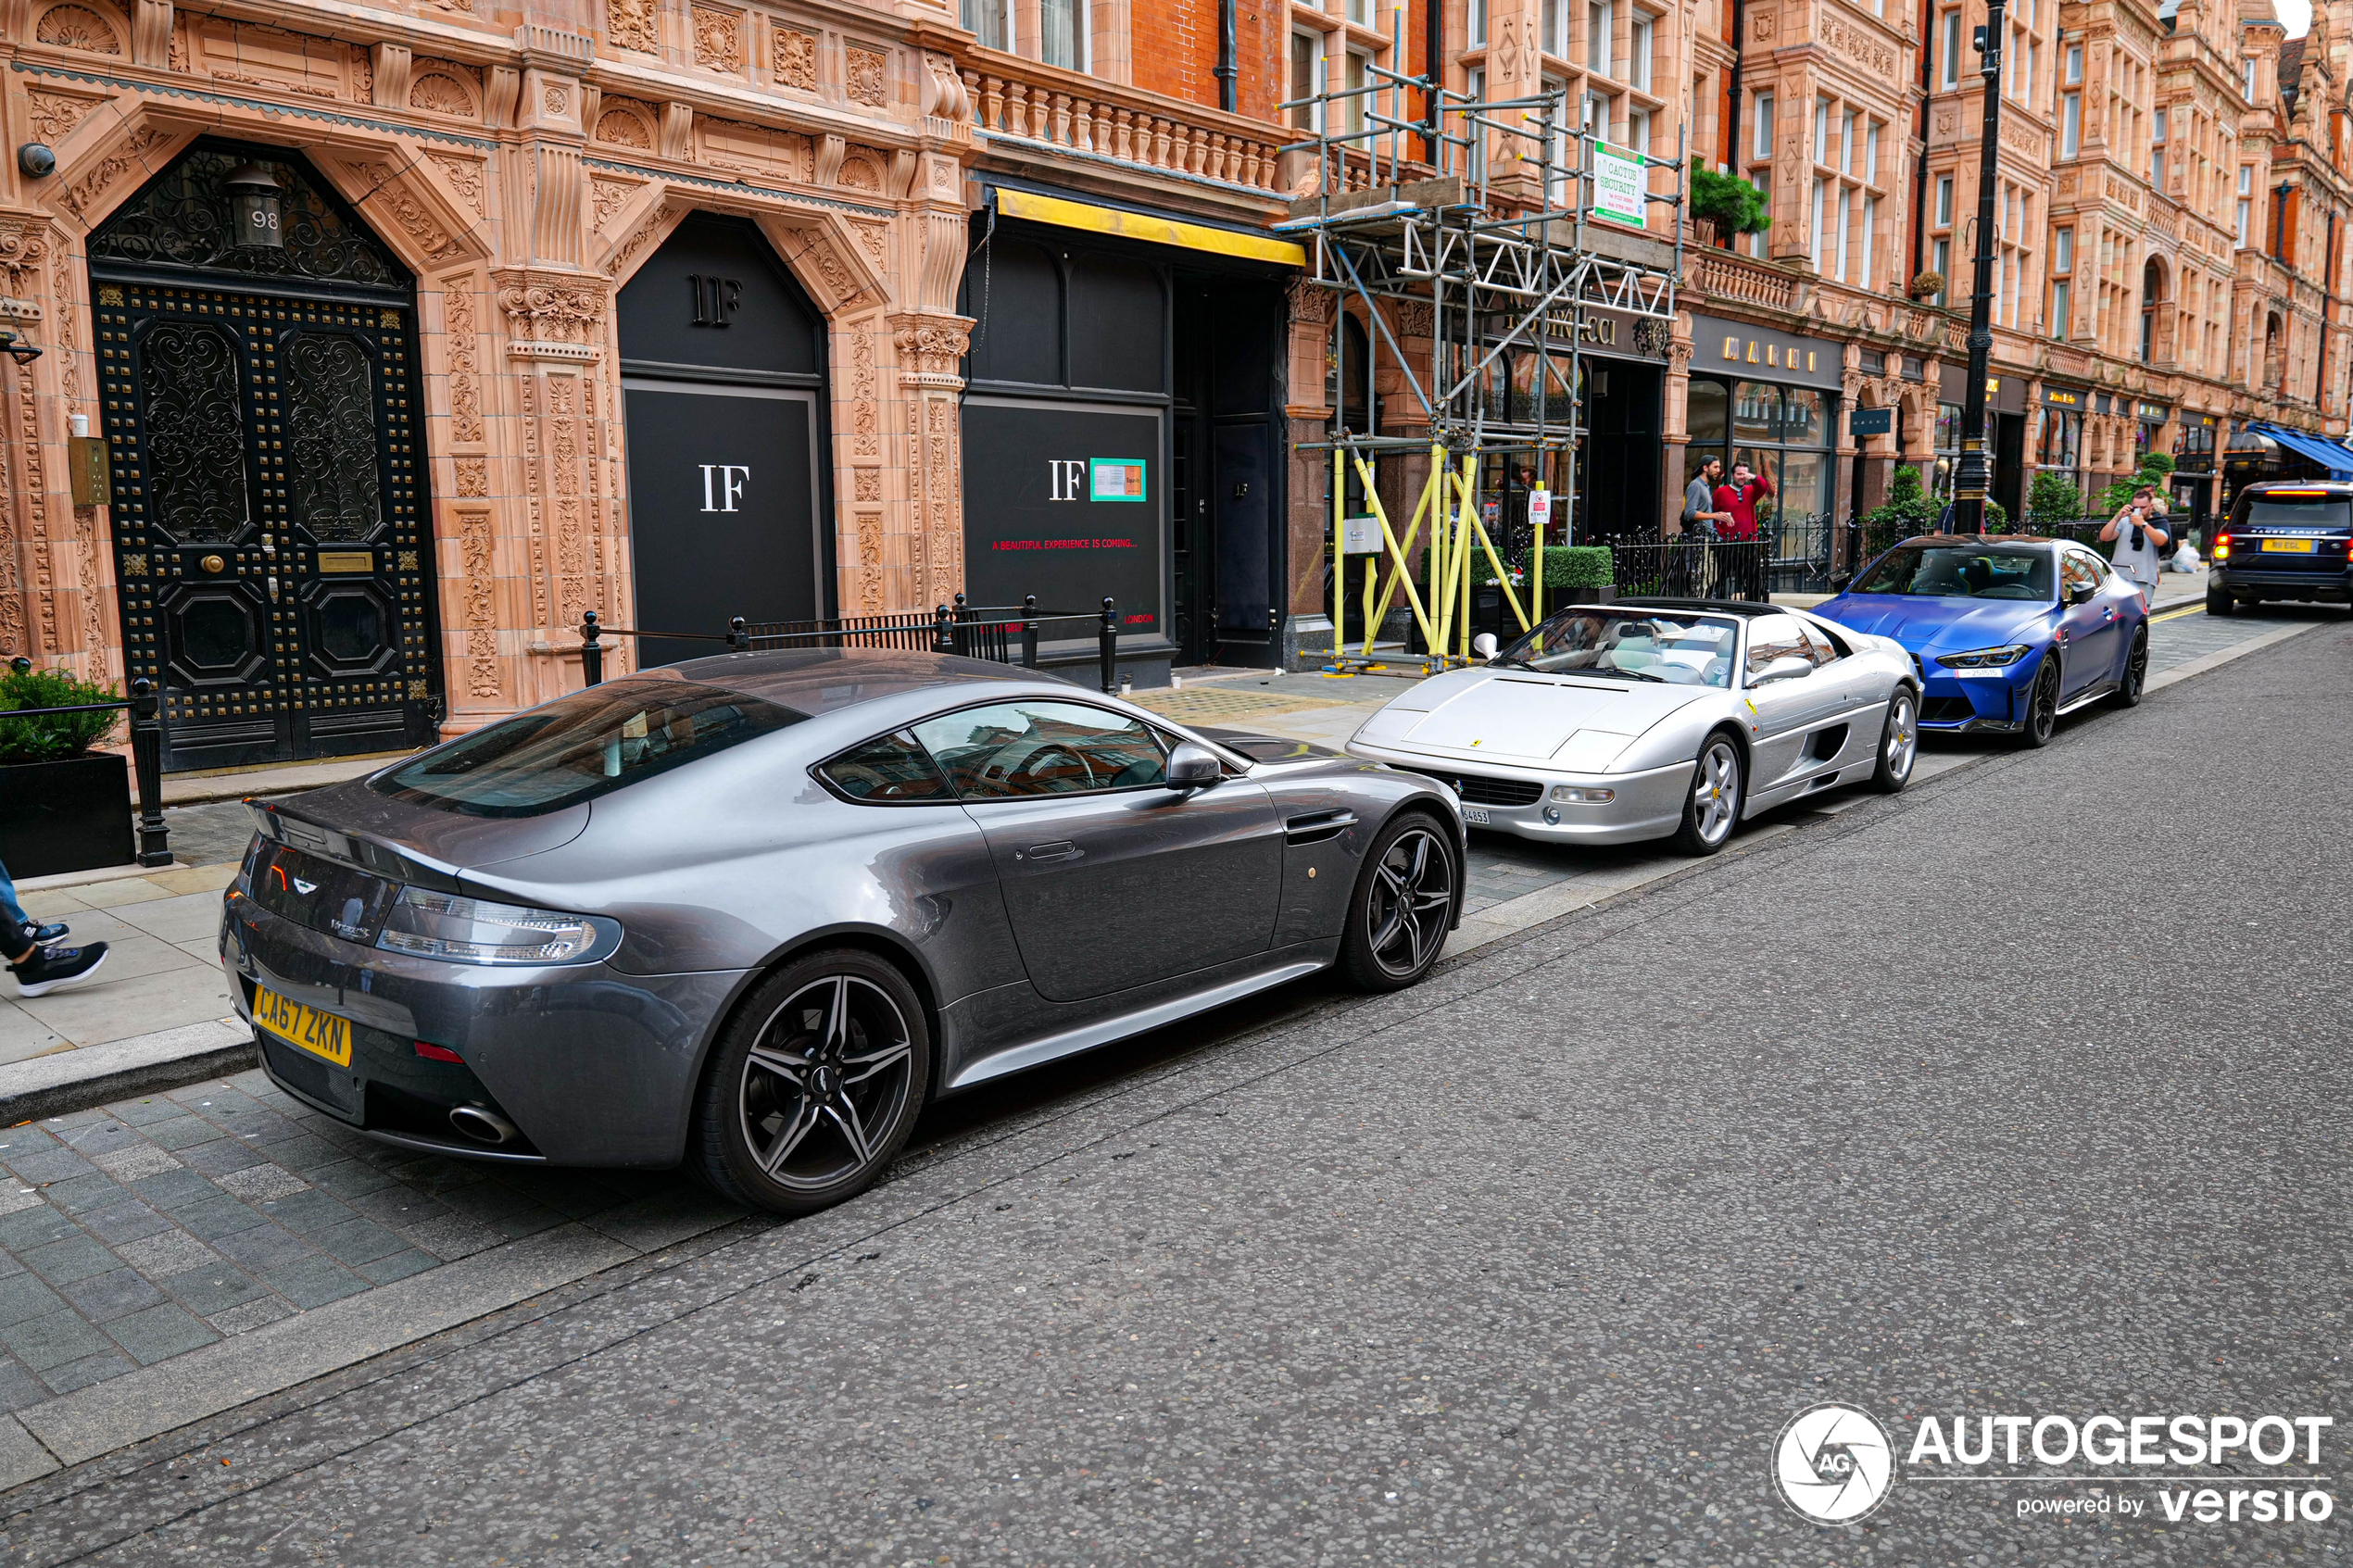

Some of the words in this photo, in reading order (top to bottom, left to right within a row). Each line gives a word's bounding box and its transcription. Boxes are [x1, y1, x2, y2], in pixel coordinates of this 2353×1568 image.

[1600, 176, 1637, 196] SECURITY
[1608, 162, 1637, 182] CACTUS
[252, 210, 278, 230] 98
[689, 273, 743, 325] IF
[1723, 336, 1817, 372] MARNI
[698, 464, 749, 511] IF
[1049, 460, 1085, 500] IF
[992, 541, 999, 550] A
[1000, 540, 1043, 550] BEAUTIFUL
[1044, 539, 1089, 549] EXPERIENCE
[1092, 539, 1101, 548] IS
[1101, 538, 1138, 548] COMING...
[1125, 614, 1153, 624] LONDON
[260, 986, 303, 1035] CA67
[304, 1007, 345, 1056] ZKN
